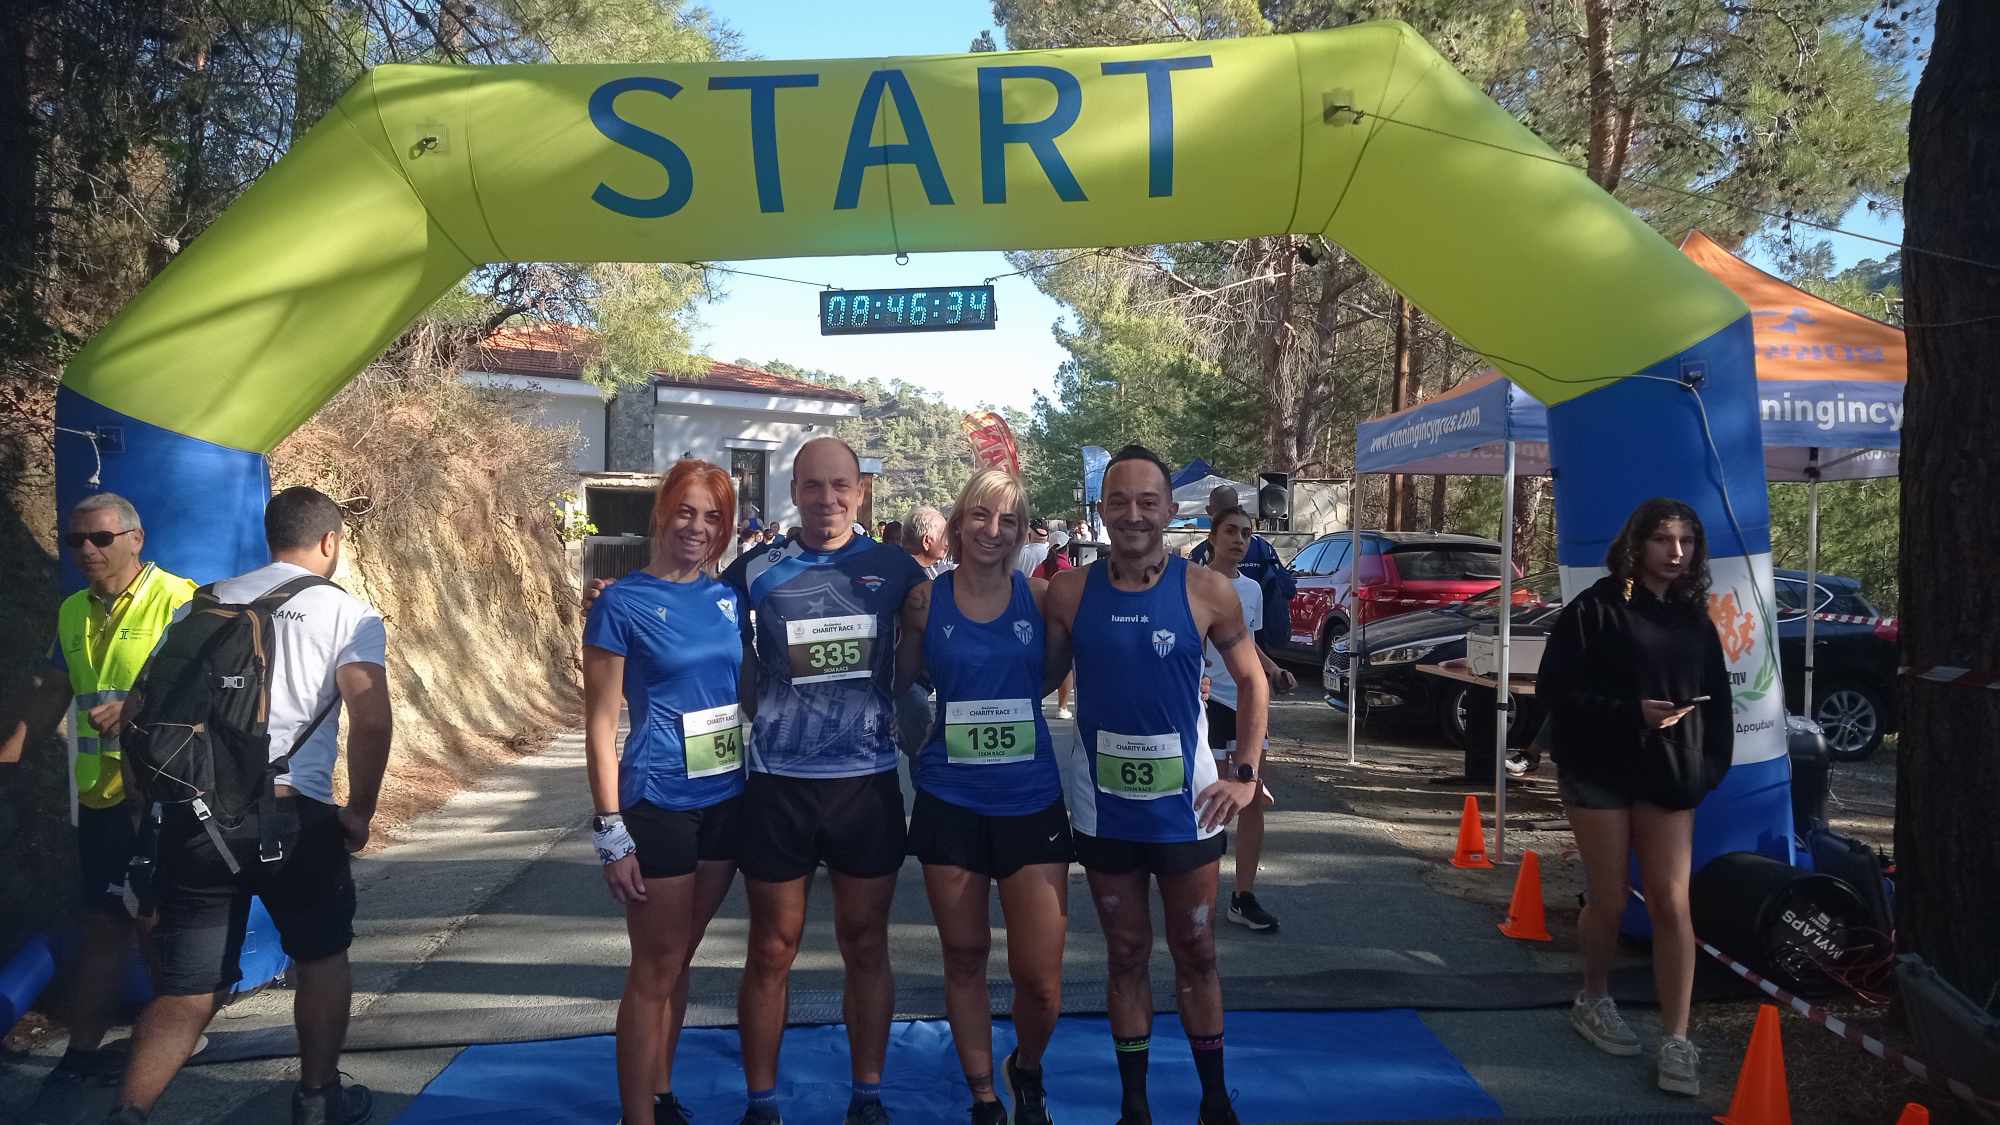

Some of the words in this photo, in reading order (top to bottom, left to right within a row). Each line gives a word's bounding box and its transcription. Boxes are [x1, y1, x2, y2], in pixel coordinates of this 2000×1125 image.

[587, 55, 1213, 218] START
[827, 291, 988, 327] 08:46:34
[1370, 405, 1481, 453] www.runningincyprus.com
[812, 626, 837, 634] CHARITY
[838, 624, 854, 632] RACE
[809, 641, 861, 668] 335
[969, 709, 994, 717] CHARITY
[713, 733, 736, 758] 54
[968, 726, 1016, 750] 135
[1116, 744, 1140, 752] CHARITY
[1141, 744, 1158, 752] RACE
[1121, 762, 1154, 785] 63
